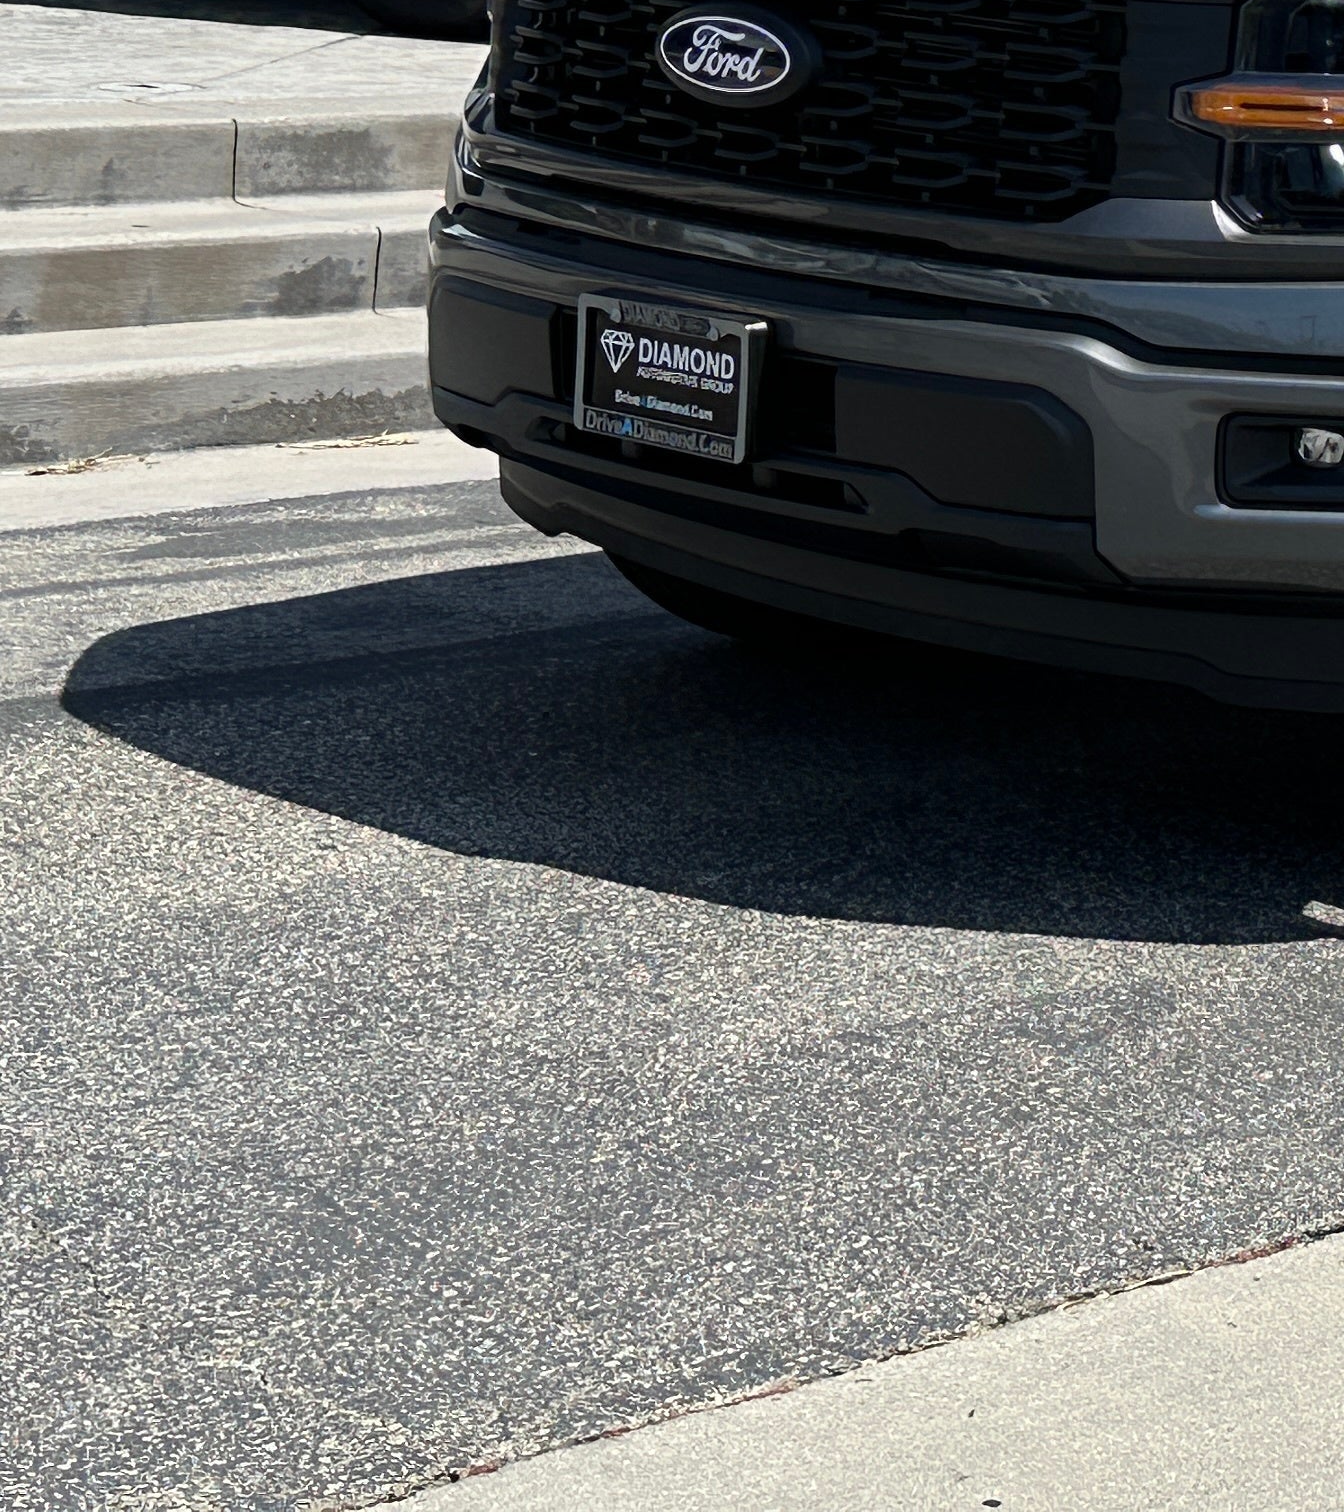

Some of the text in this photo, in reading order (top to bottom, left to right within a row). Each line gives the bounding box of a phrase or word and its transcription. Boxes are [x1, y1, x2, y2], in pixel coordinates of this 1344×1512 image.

[683, 24, 765, 83] Ford
[638, 337, 736, 380] DIAMOND
[700, 377, 735, 395] GROUP
